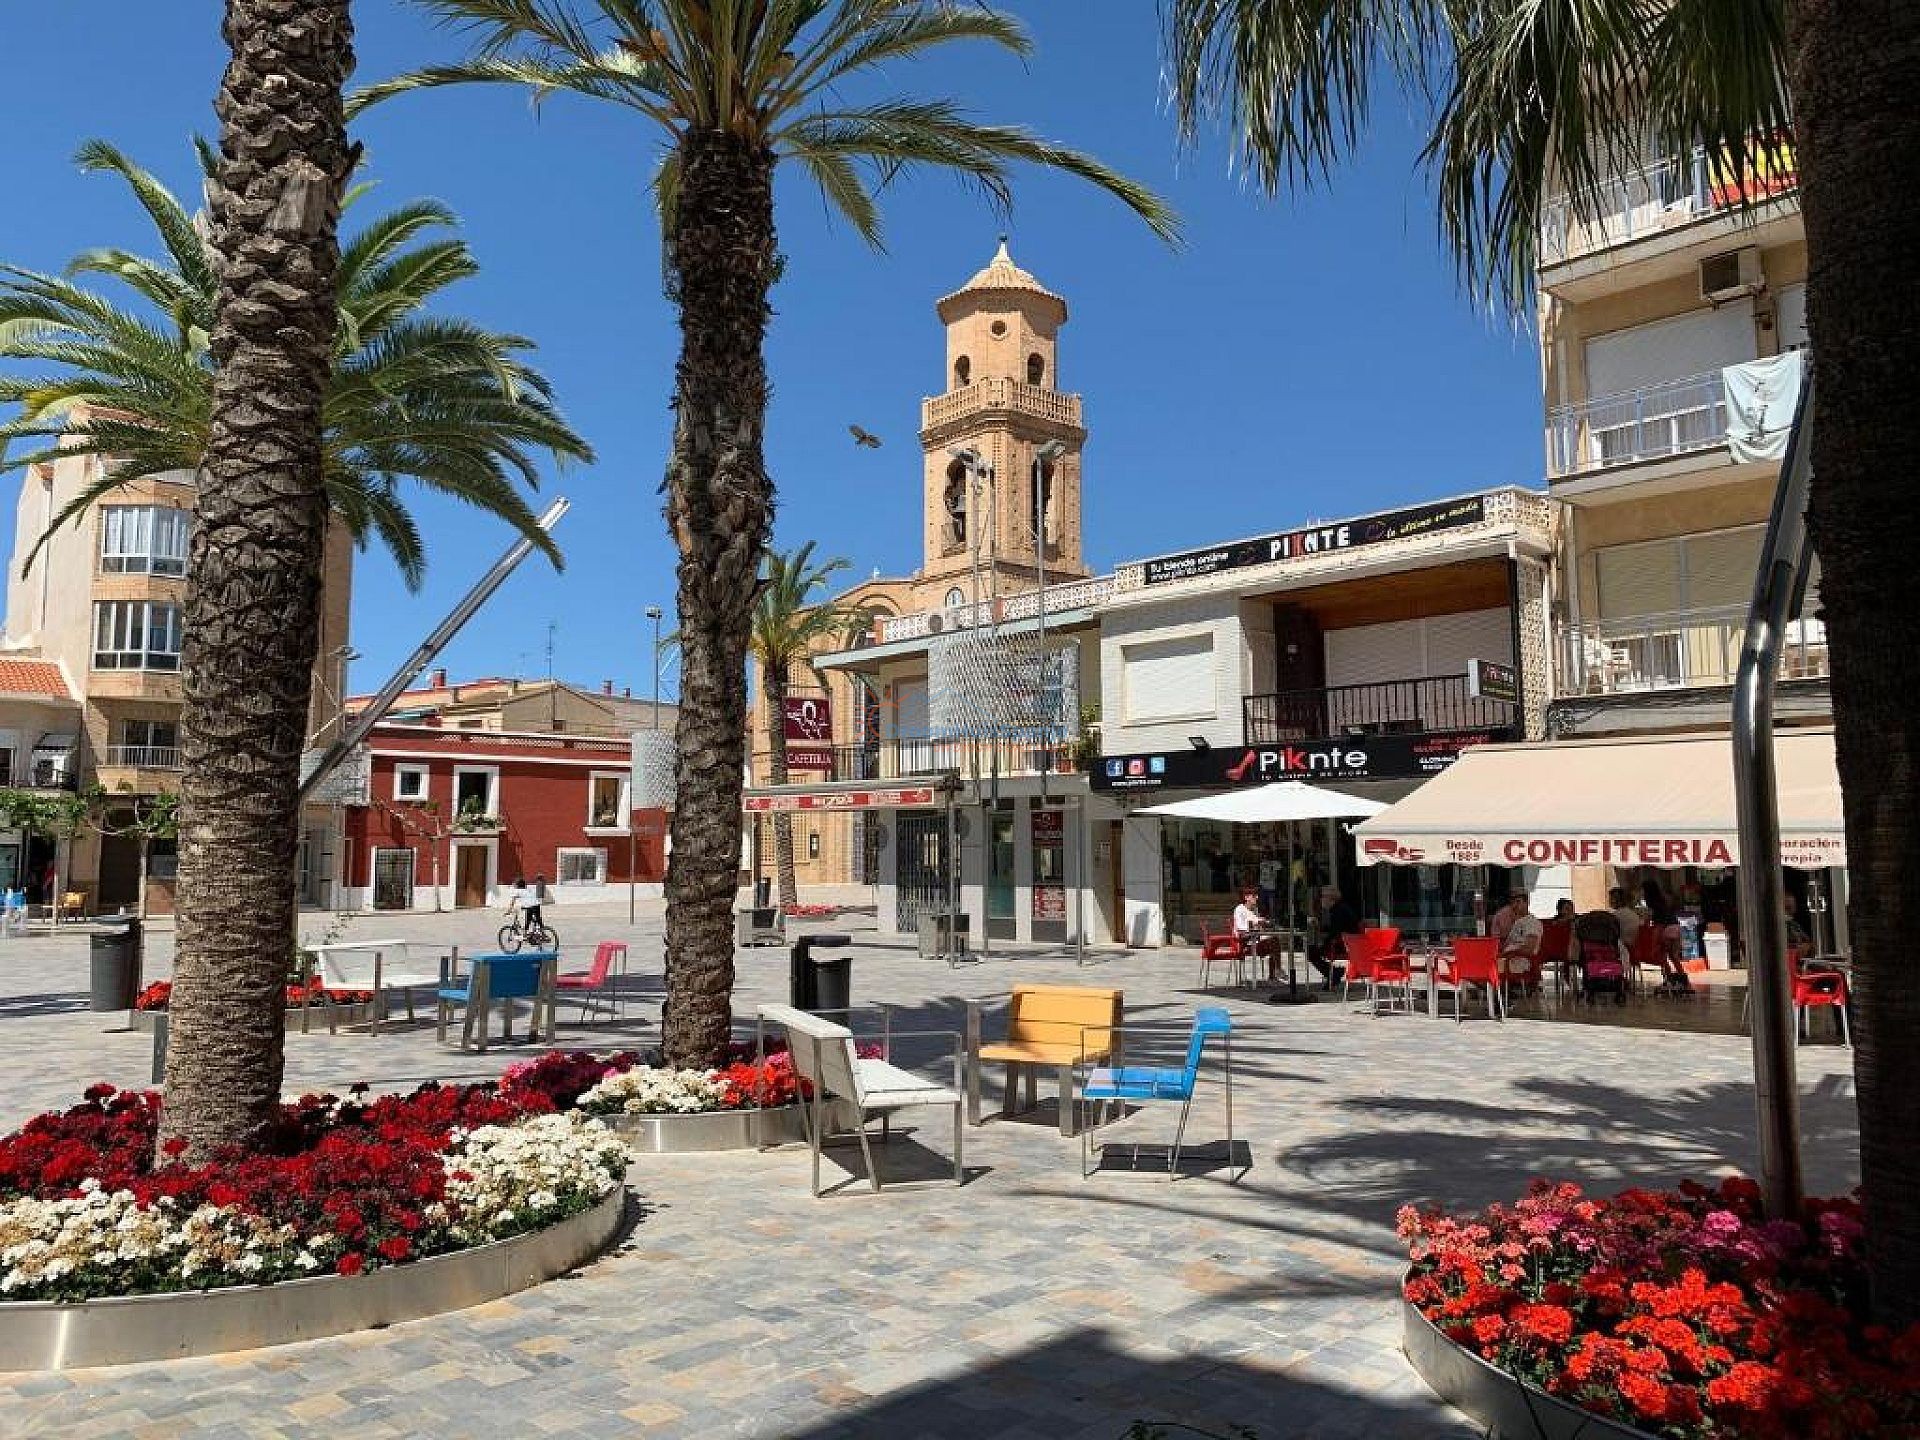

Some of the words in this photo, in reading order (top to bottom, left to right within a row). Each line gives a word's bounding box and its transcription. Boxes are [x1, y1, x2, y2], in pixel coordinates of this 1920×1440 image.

[1259, 746, 1367, 772] Piknte
[1446, 839, 1484, 850] Desde
[1503, 839, 1732, 863] CONFITERIA
[1780, 853, 1822, 865] ropia
